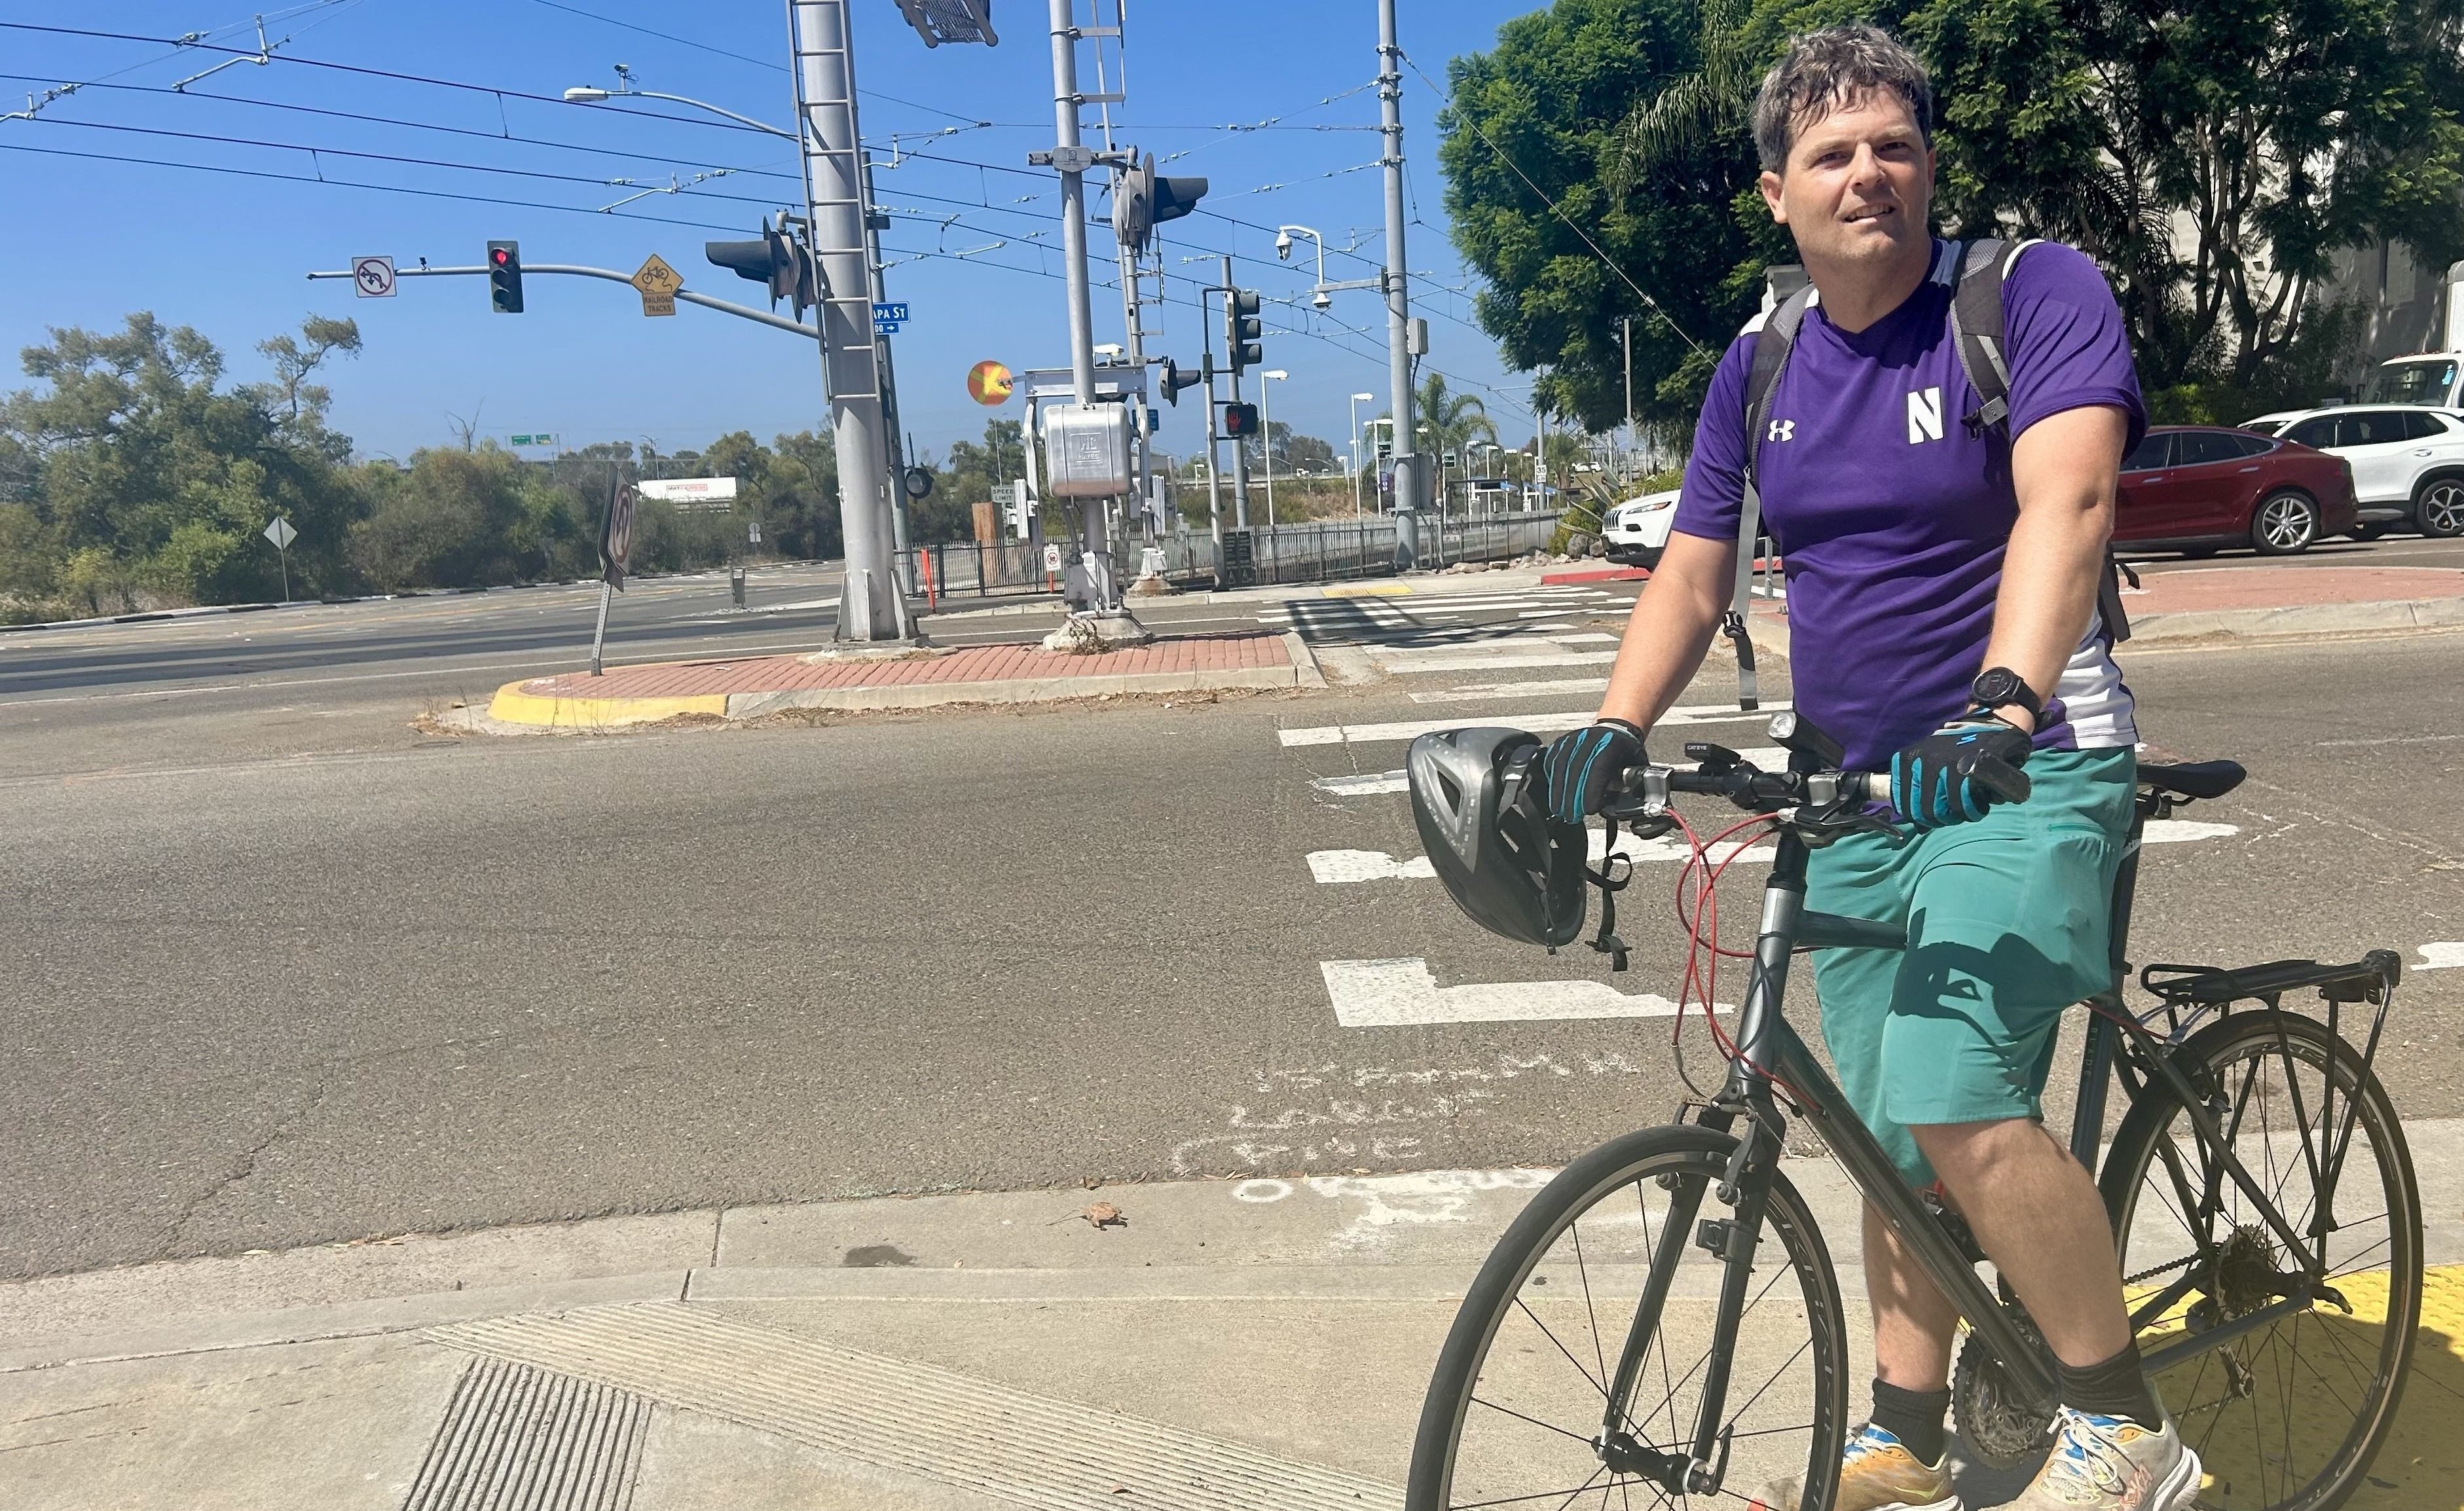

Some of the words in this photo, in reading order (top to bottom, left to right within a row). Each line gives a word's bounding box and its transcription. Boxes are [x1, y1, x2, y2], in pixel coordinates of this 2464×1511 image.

[648, 304, 672, 313] TRACKS
[1908, 387, 1944, 445] N
[2084, 1027, 2098, 1076] BLADE
